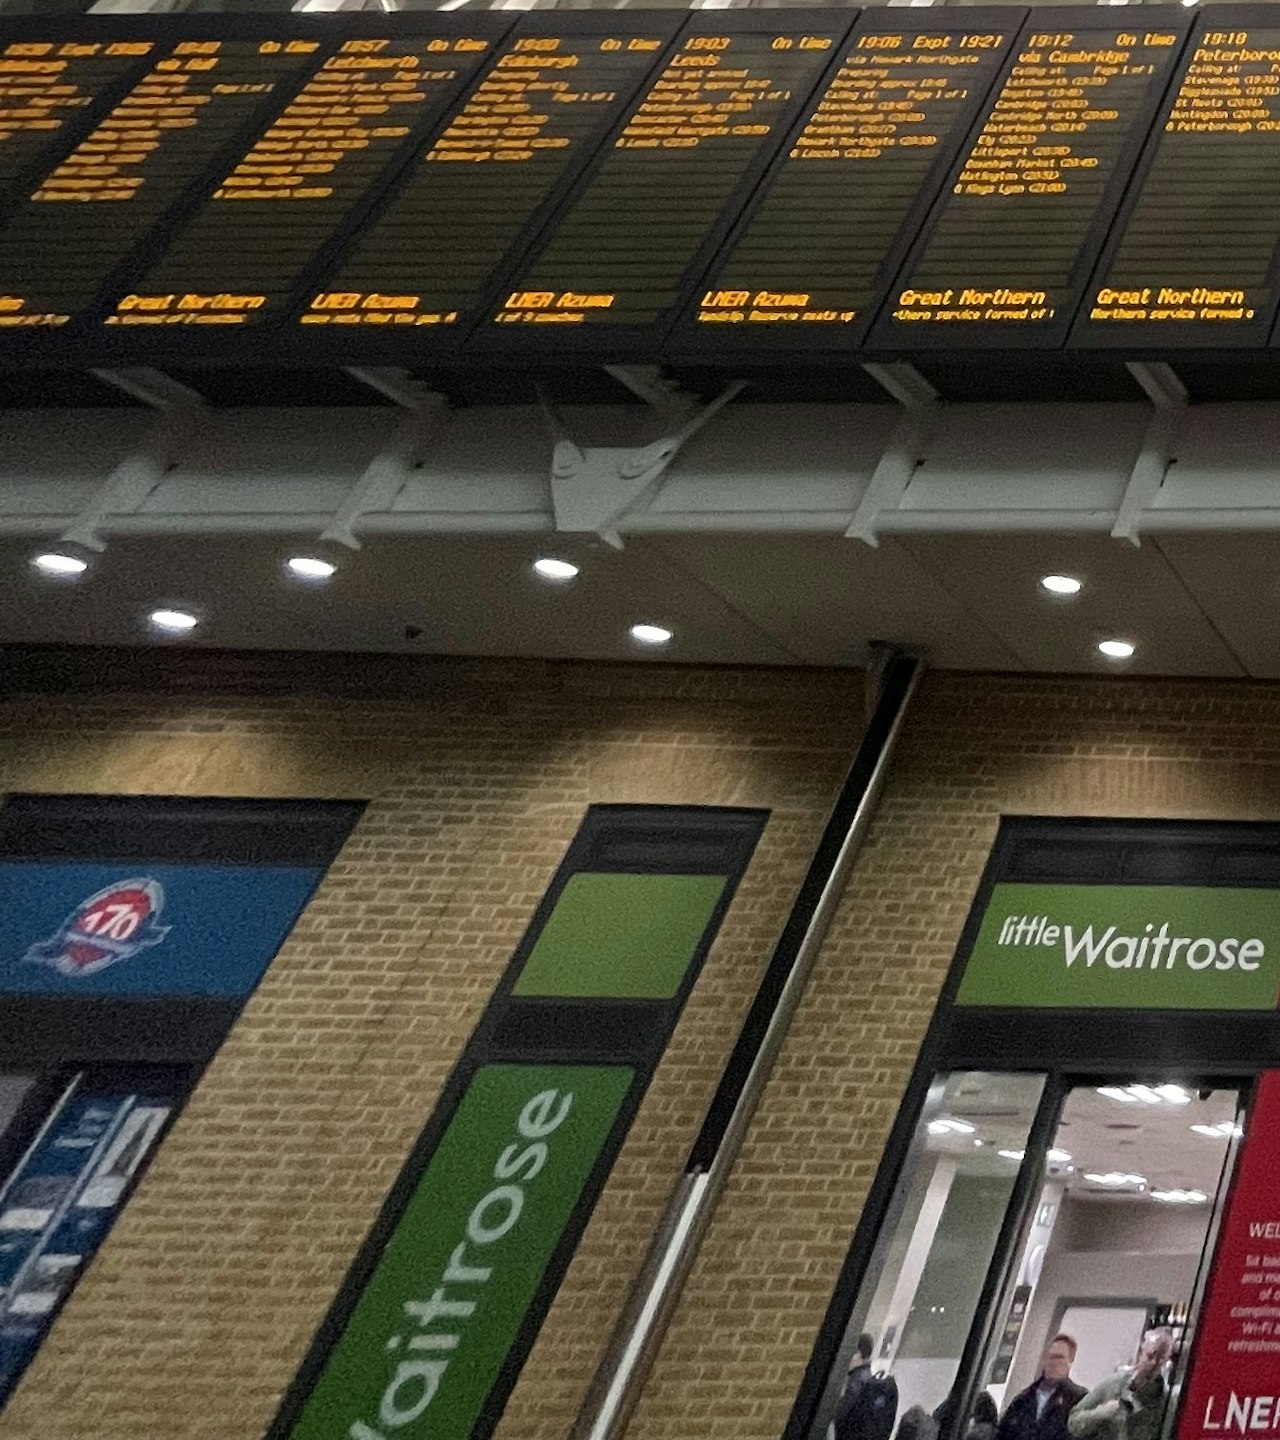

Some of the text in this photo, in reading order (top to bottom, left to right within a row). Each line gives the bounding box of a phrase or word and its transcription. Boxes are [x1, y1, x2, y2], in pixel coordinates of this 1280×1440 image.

[685, 37, 832, 49] 19:03 On time
[858, 36, 1002, 49] 19:06 Expt 19:21
[1029, 34, 1176, 47] 19:12 On time
[671, 54, 720, 66] Leeds
[1019, 50, 1129, 64] via Cambridge
[701, 291, 809, 306] LNER Azuma
[900, 289, 1045, 305] Great Northern
[1097, 288, 1244, 304] Great Northern
[998, 914, 1265, 972] little Waitrose
